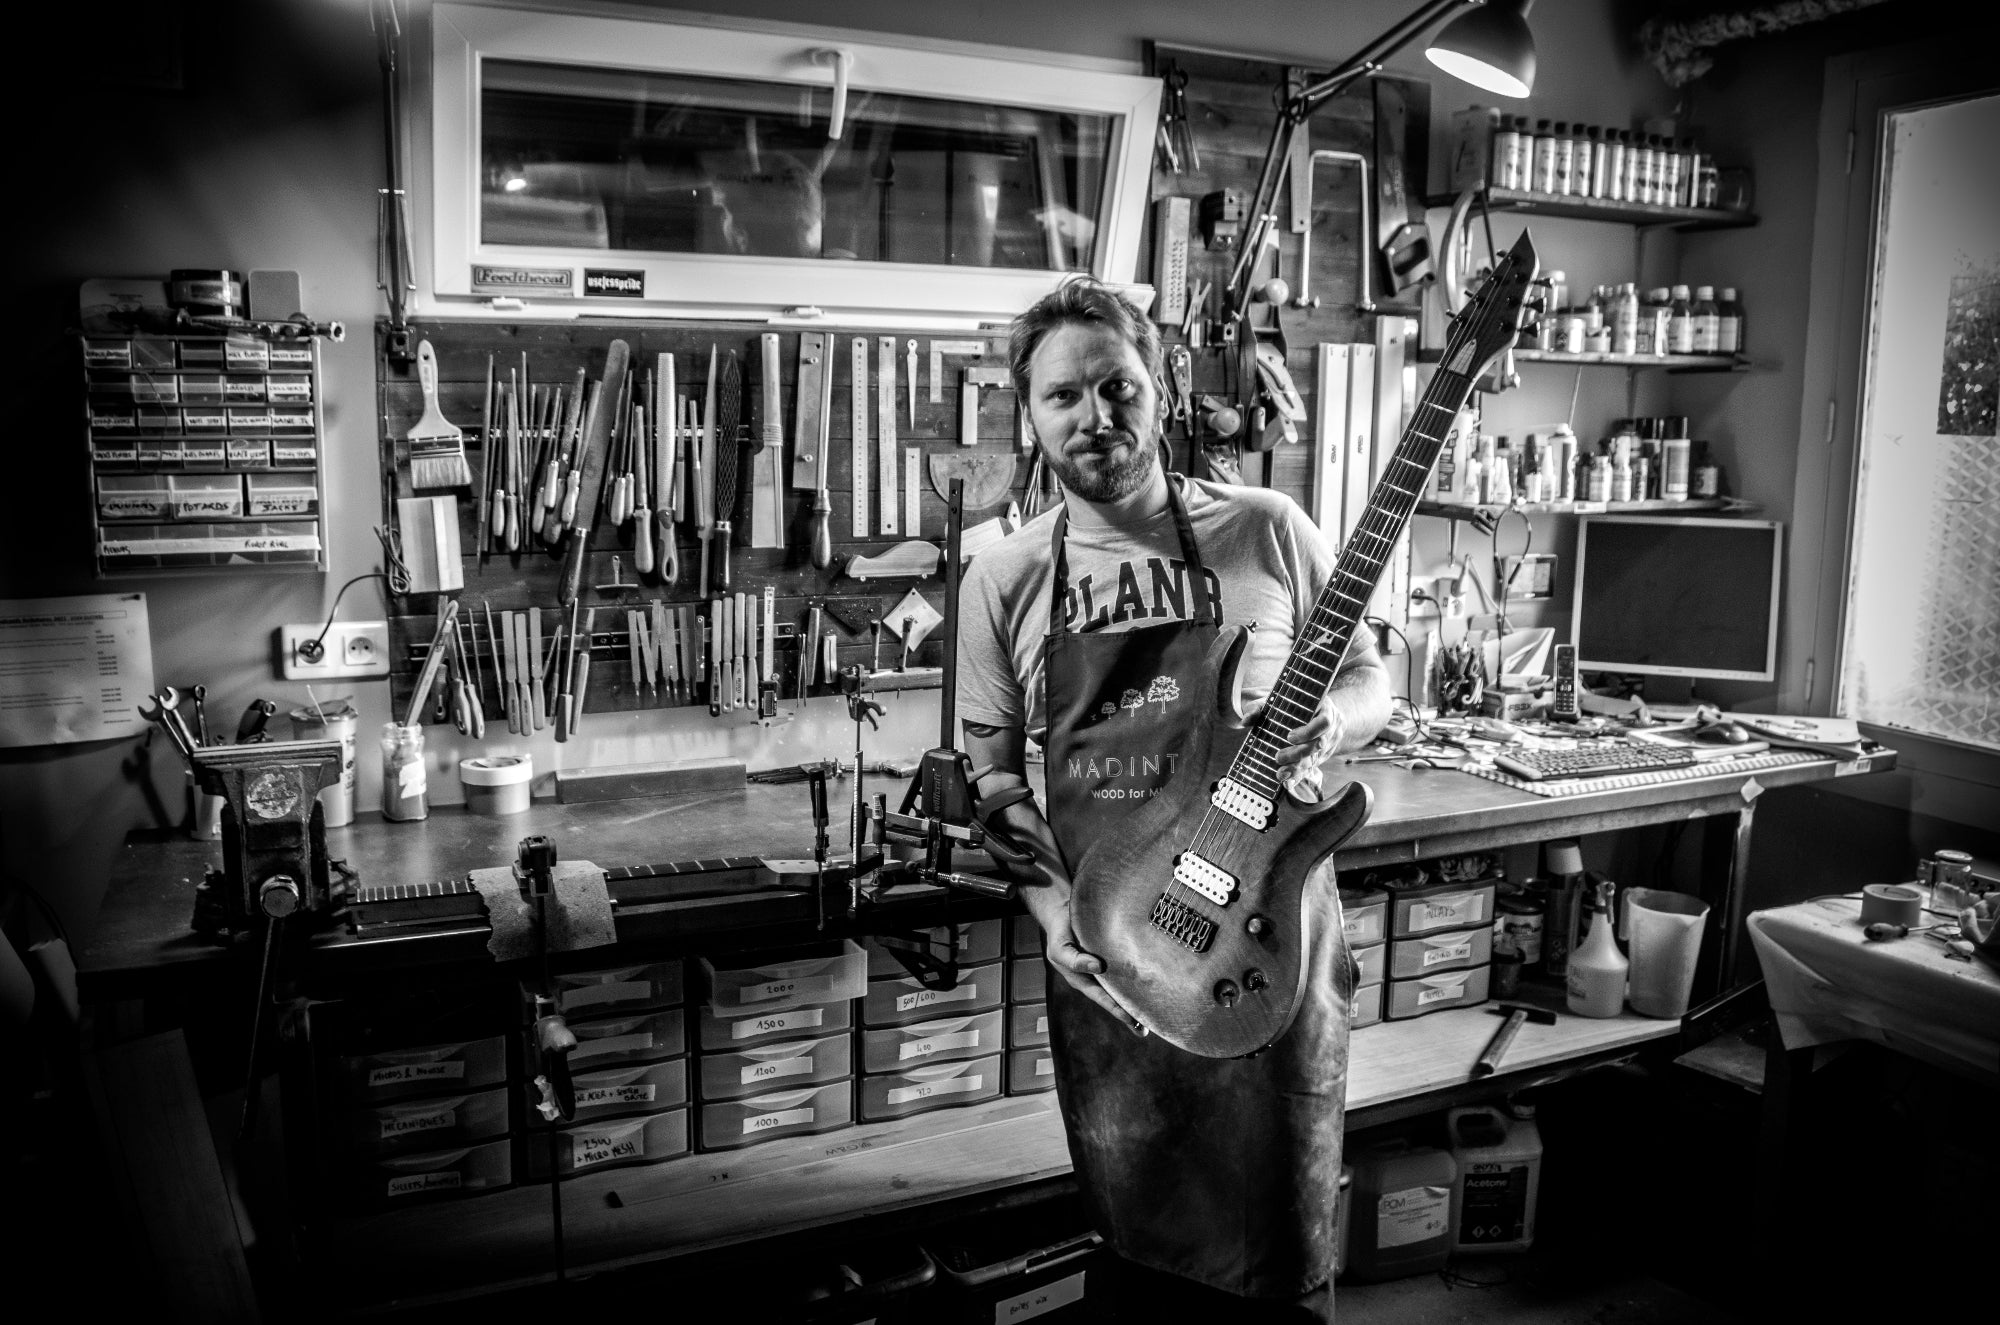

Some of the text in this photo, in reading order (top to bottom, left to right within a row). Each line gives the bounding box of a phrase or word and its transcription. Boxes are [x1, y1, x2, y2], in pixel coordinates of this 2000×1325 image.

[1068, 753, 1179, 779] MADINT
[1091, 789, 1125, 799] WOOD
[1129, 788, 1145, 799] for
[766, 983, 794, 993] 2000
[757, 1018, 785, 1029] 1500
[916, 1043, 932, 1052] 400
[754, 1066, 776, 1076] 1200
[754, 1117, 779, 1127] 1000
